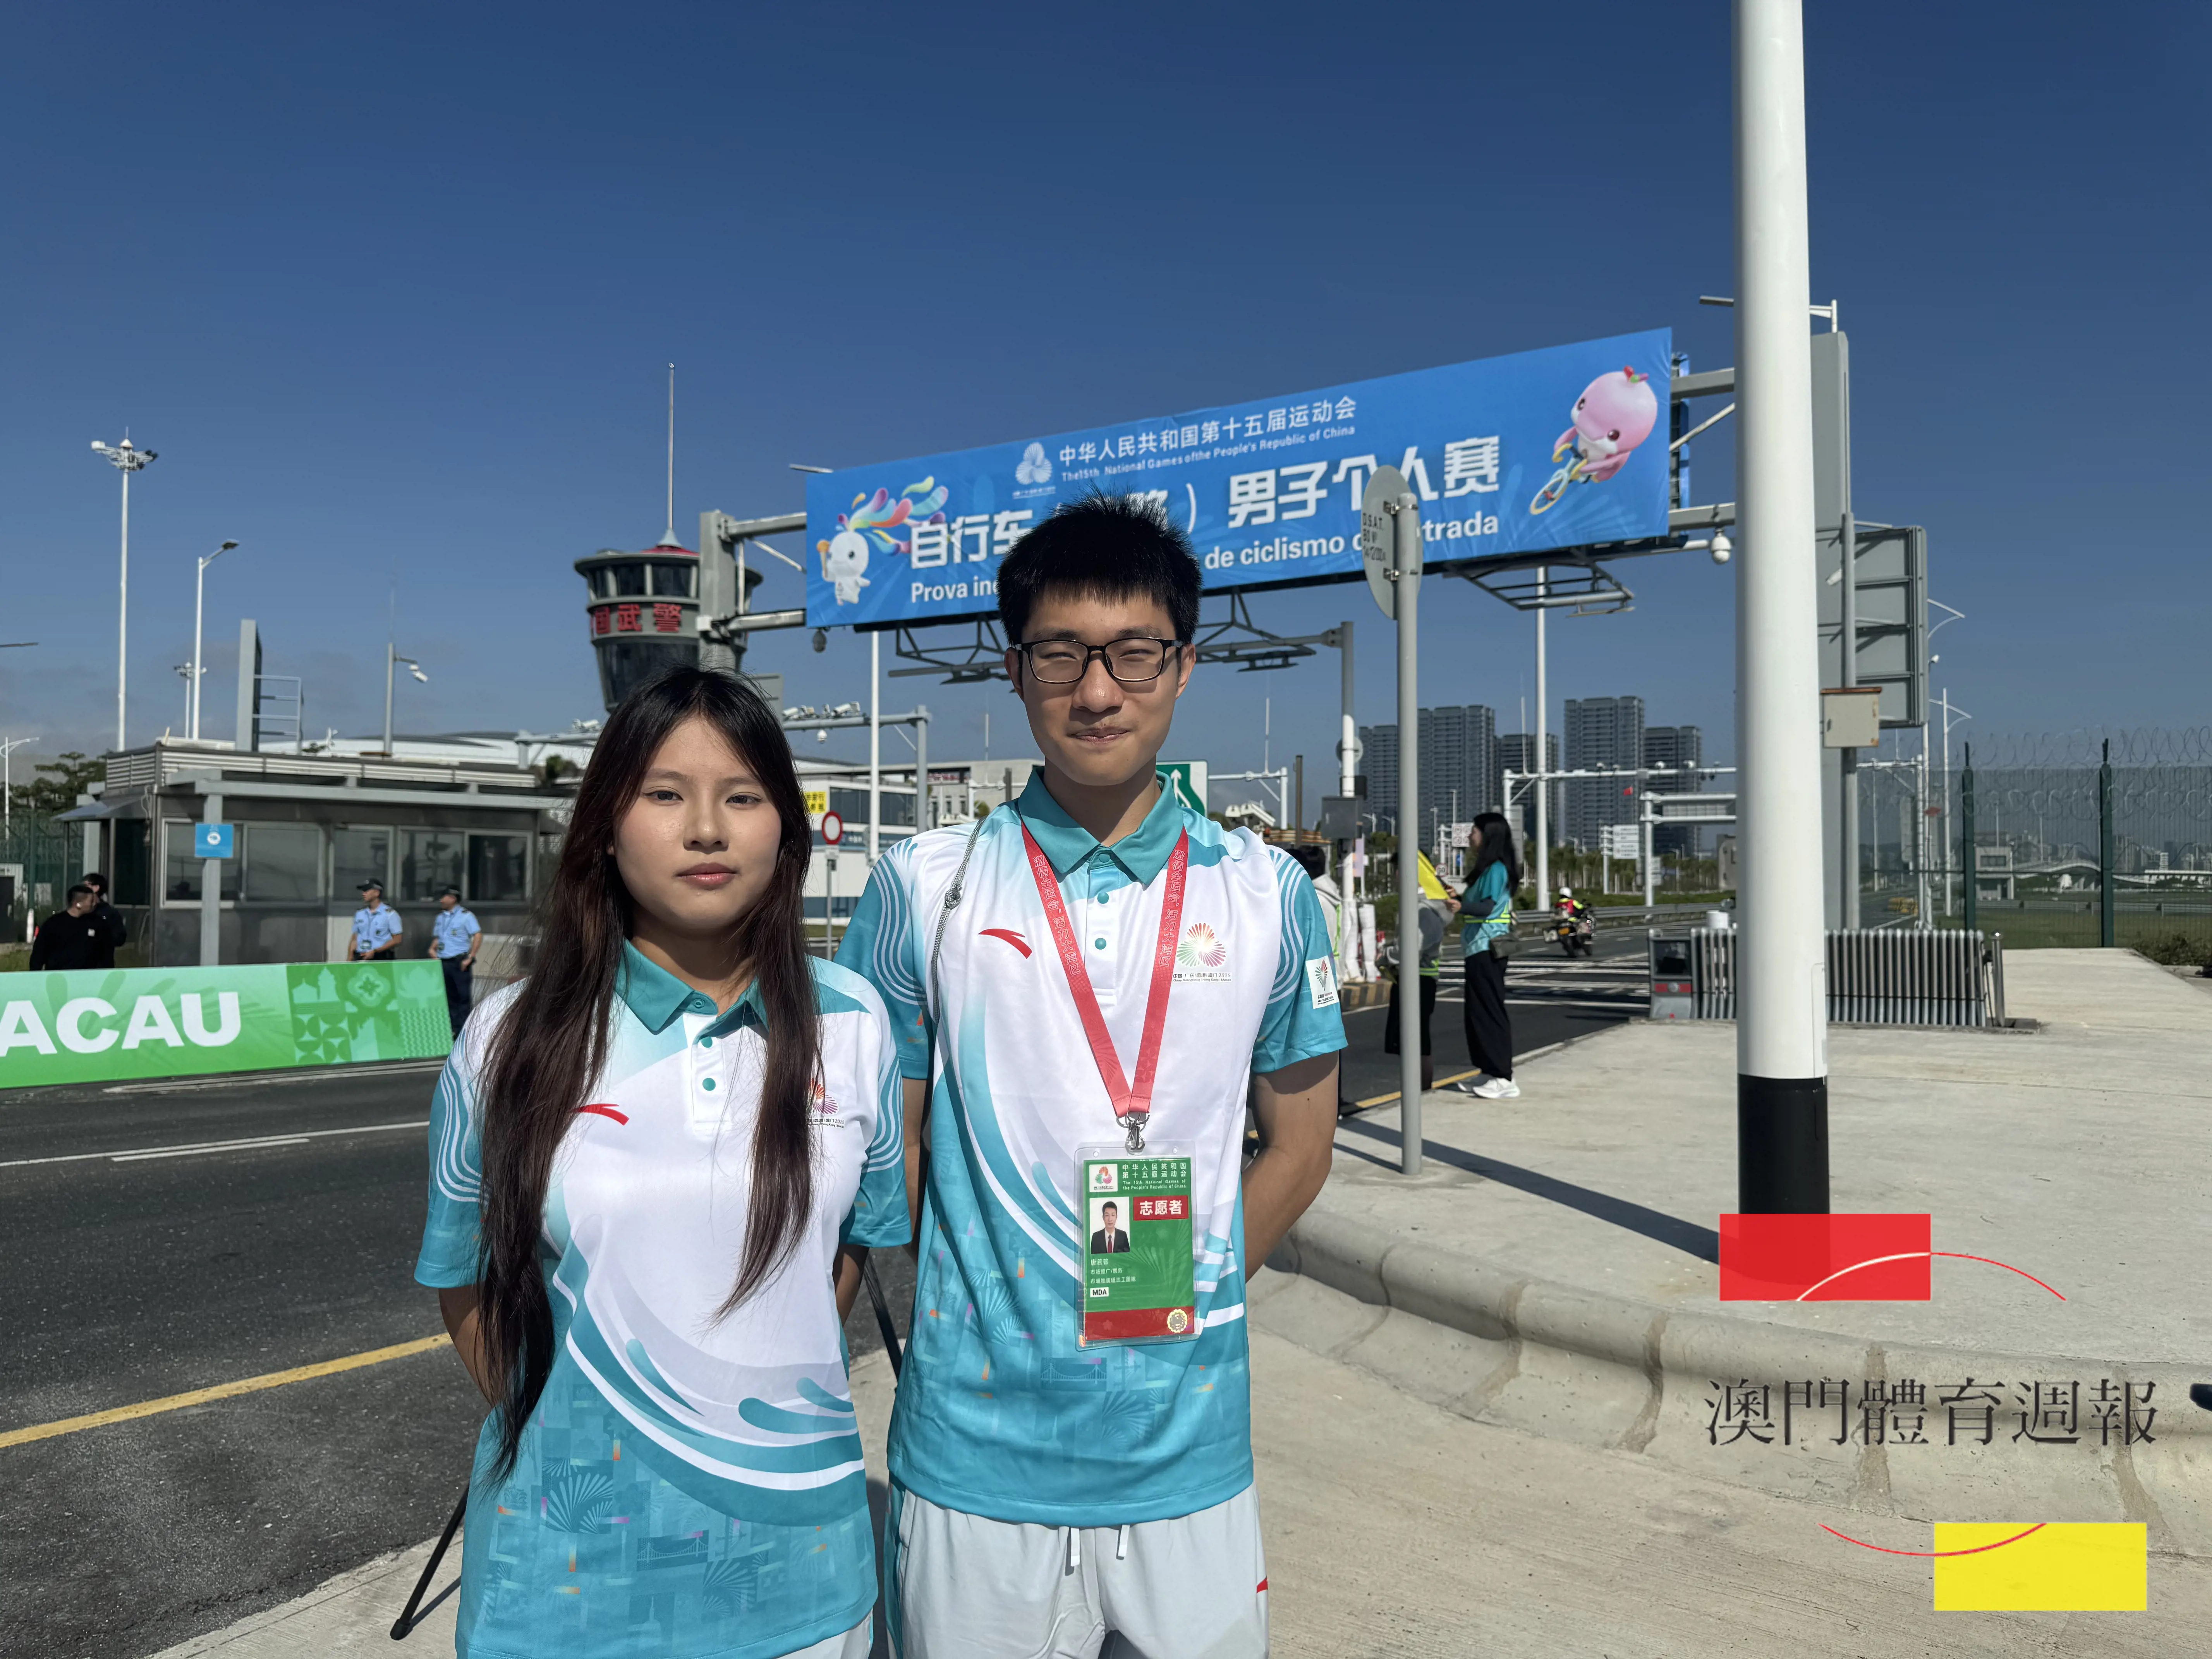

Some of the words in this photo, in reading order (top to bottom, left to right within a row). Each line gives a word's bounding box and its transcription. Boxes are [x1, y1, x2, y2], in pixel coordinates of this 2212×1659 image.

[1060, 395, 1356, 467] 中华人民共和国第十五届运动会
[1105, 460, 1146, 475] National
[1147, 455, 1183, 469] Games
[1214, 442, 1257, 458] People's
[1259, 433, 1306, 450] Republic
[1309, 429, 1321, 441] of
[1323, 426, 1355, 439] China
[911, 581, 968, 603] Prova
[1204, 546, 1234, 570] de
[1240, 534, 1345, 565] ciclismo
[1422, 511, 1498, 542] trada
[592, 603, 682, 634] 国武警
[1122, 1163, 1186, 1171] 中华人民共和国
[1122, 1170, 1187, 1179] 第十五届运动会
[1139, 1200, 1182, 1216] 志愿者
